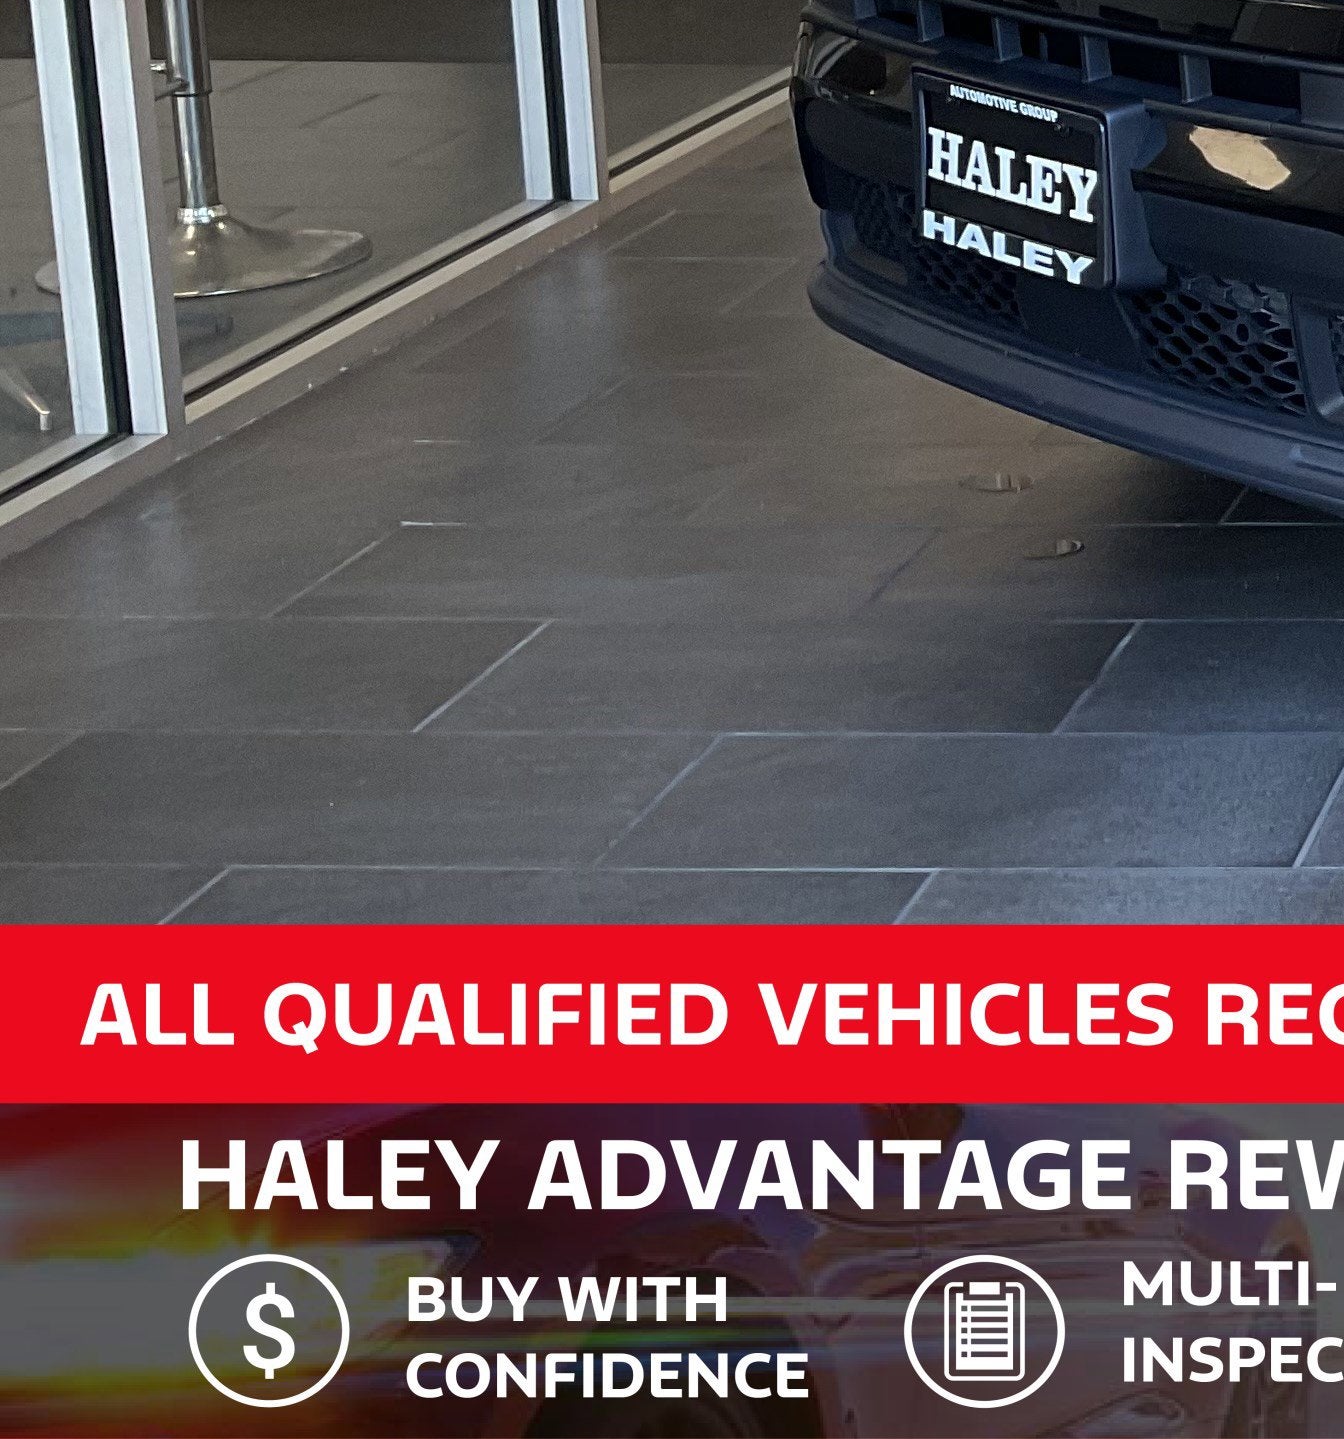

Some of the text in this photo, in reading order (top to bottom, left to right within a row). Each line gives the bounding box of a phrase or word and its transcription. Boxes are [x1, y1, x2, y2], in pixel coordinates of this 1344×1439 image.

[949, 84, 1059, 123] AUTOMOTIVE GROUP
[927, 126, 1098, 223] HALEY
[923, 209, 1094, 285] HALEY
